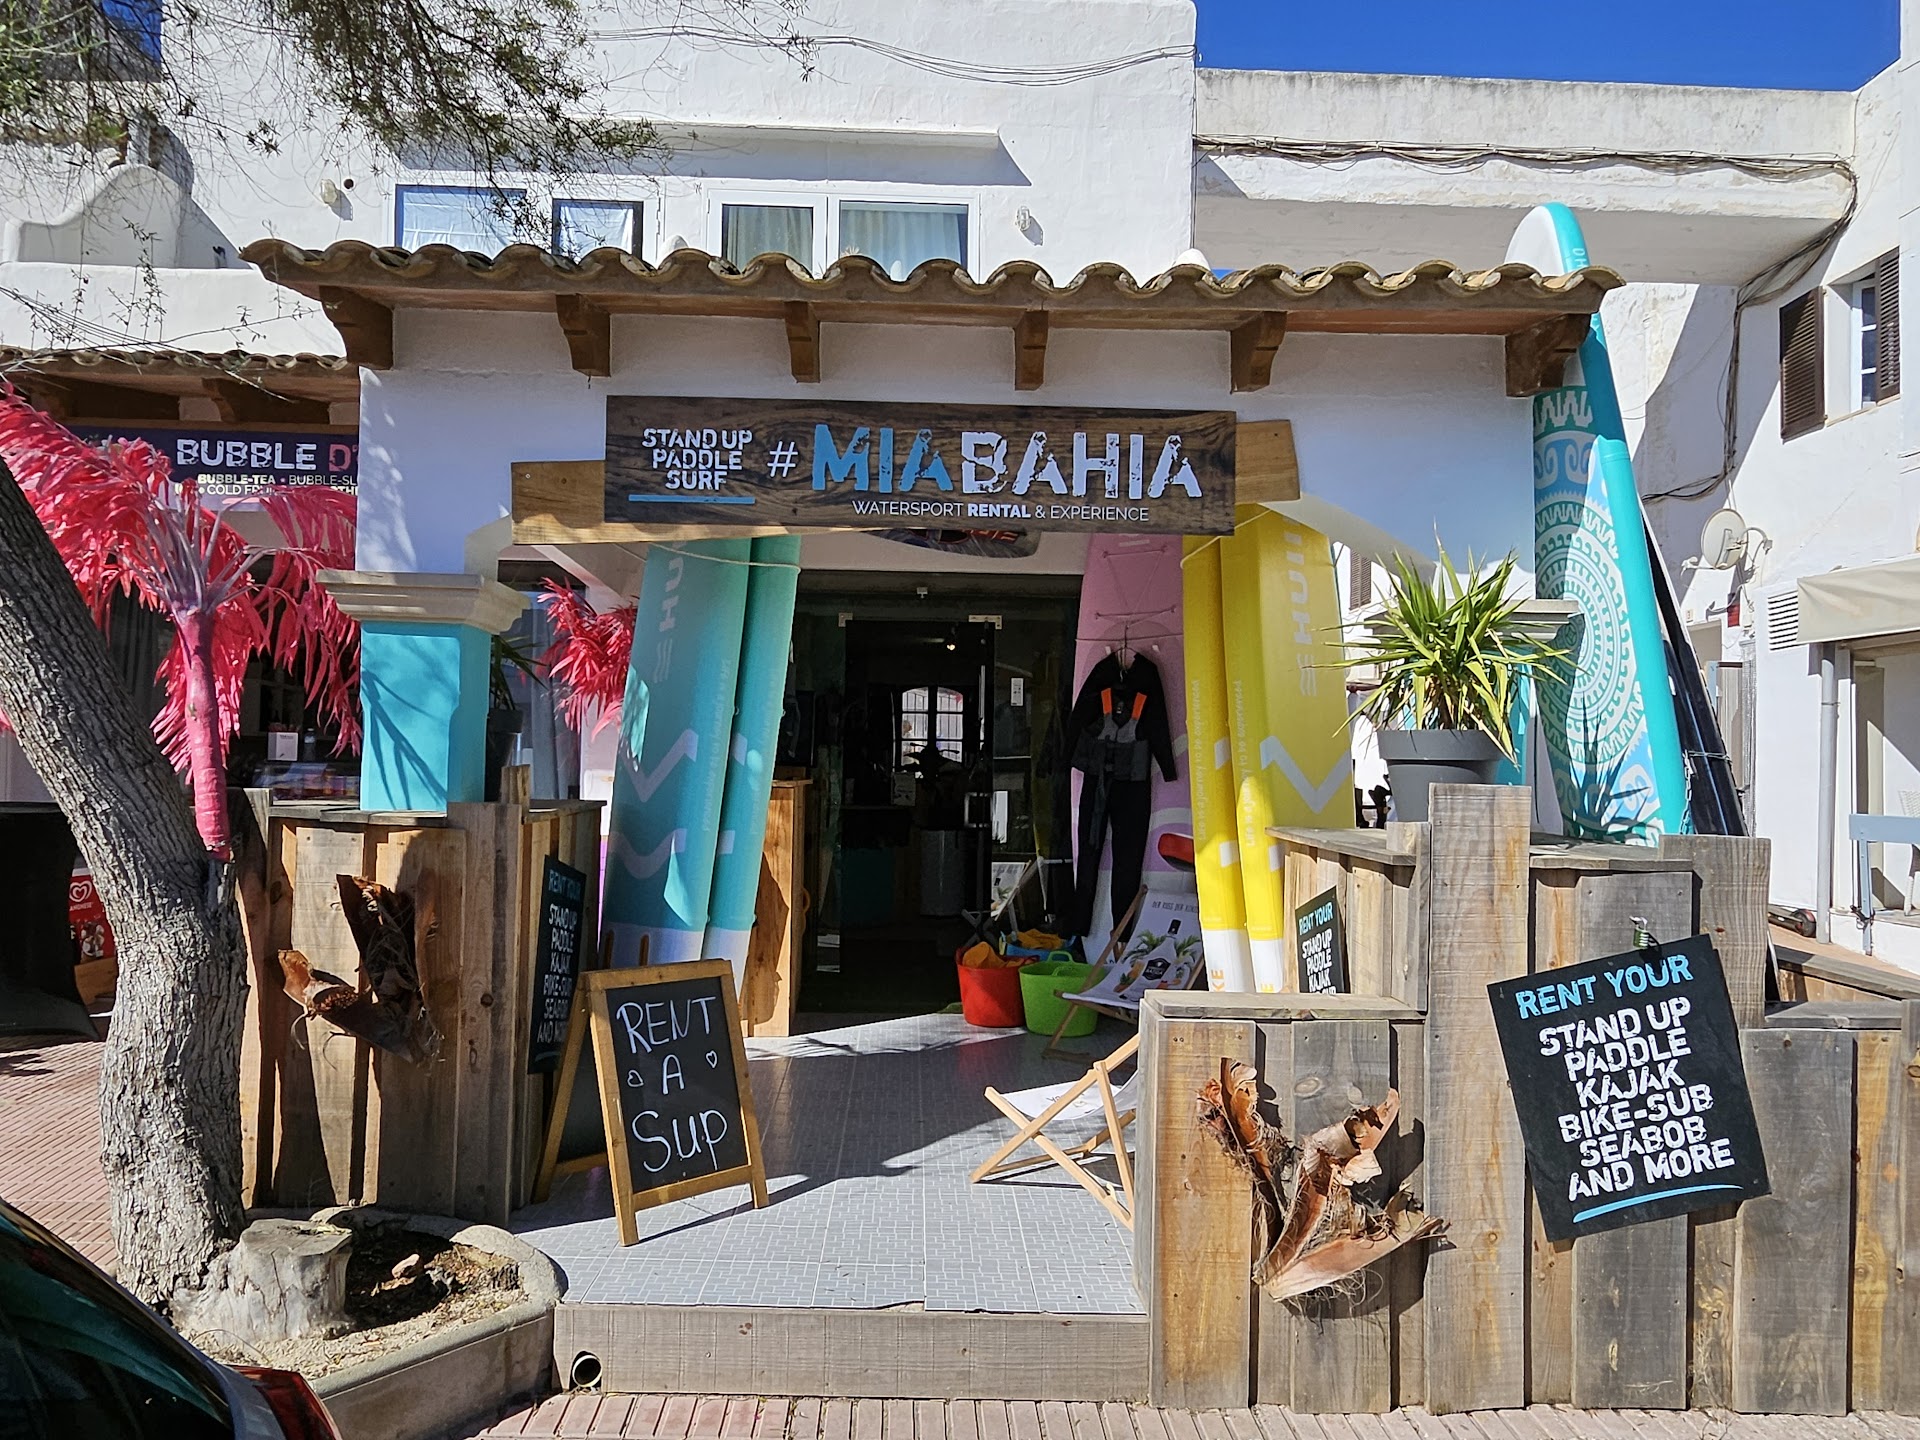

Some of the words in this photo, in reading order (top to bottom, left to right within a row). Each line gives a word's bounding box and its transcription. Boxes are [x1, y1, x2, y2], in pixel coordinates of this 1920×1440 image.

[176, 438, 318, 471] BUBBLE
[641, 428, 718, 450] STAND
[721, 429, 753, 451] UP
[652, 448, 743, 471] PADDLE
[197, 473, 276, 486] BUBBLE-TEA
[288, 474, 358, 486] BUBBLE-SL
[206, 485, 242, 496] COLD
[665, 469, 728, 491] SURF
[852, 500, 964, 517] WATERSPORT
[967, 502, 1031, 519] RENTAL
[1034, 505, 1047, 519] &
[1050, 505, 1150, 522] EXPERIENCE
[1299, 912, 1316, 936] RENT
[1315, 901, 1334, 927] YOUR
[1302, 932, 1322, 959] STAND
[1321, 928, 1333, 950] UP
[1306, 948, 1332, 976] PADDLE
[1515, 975, 1598, 1019] RENT
[1604, 954, 1694, 998] YOUR
[616, 996, 717, 1054] RENT
[1539, 1007, 1641, 1056] STAND
[1646, 997, 1691, 1031] UP
[1564, 1027, 1691, 1081] PADDLE
[661, 1054, 686, 1095] A
[1575, 1059, 1685, 1108] KAJAK
[1558, 1084, 1715, 1143] BIKE-SUB
[1579, 1116, 1708, 1168] SEABOB
[1568, 1161, 1634, 1201] AND
[1643, 1138, 1735, 1185] MORE
